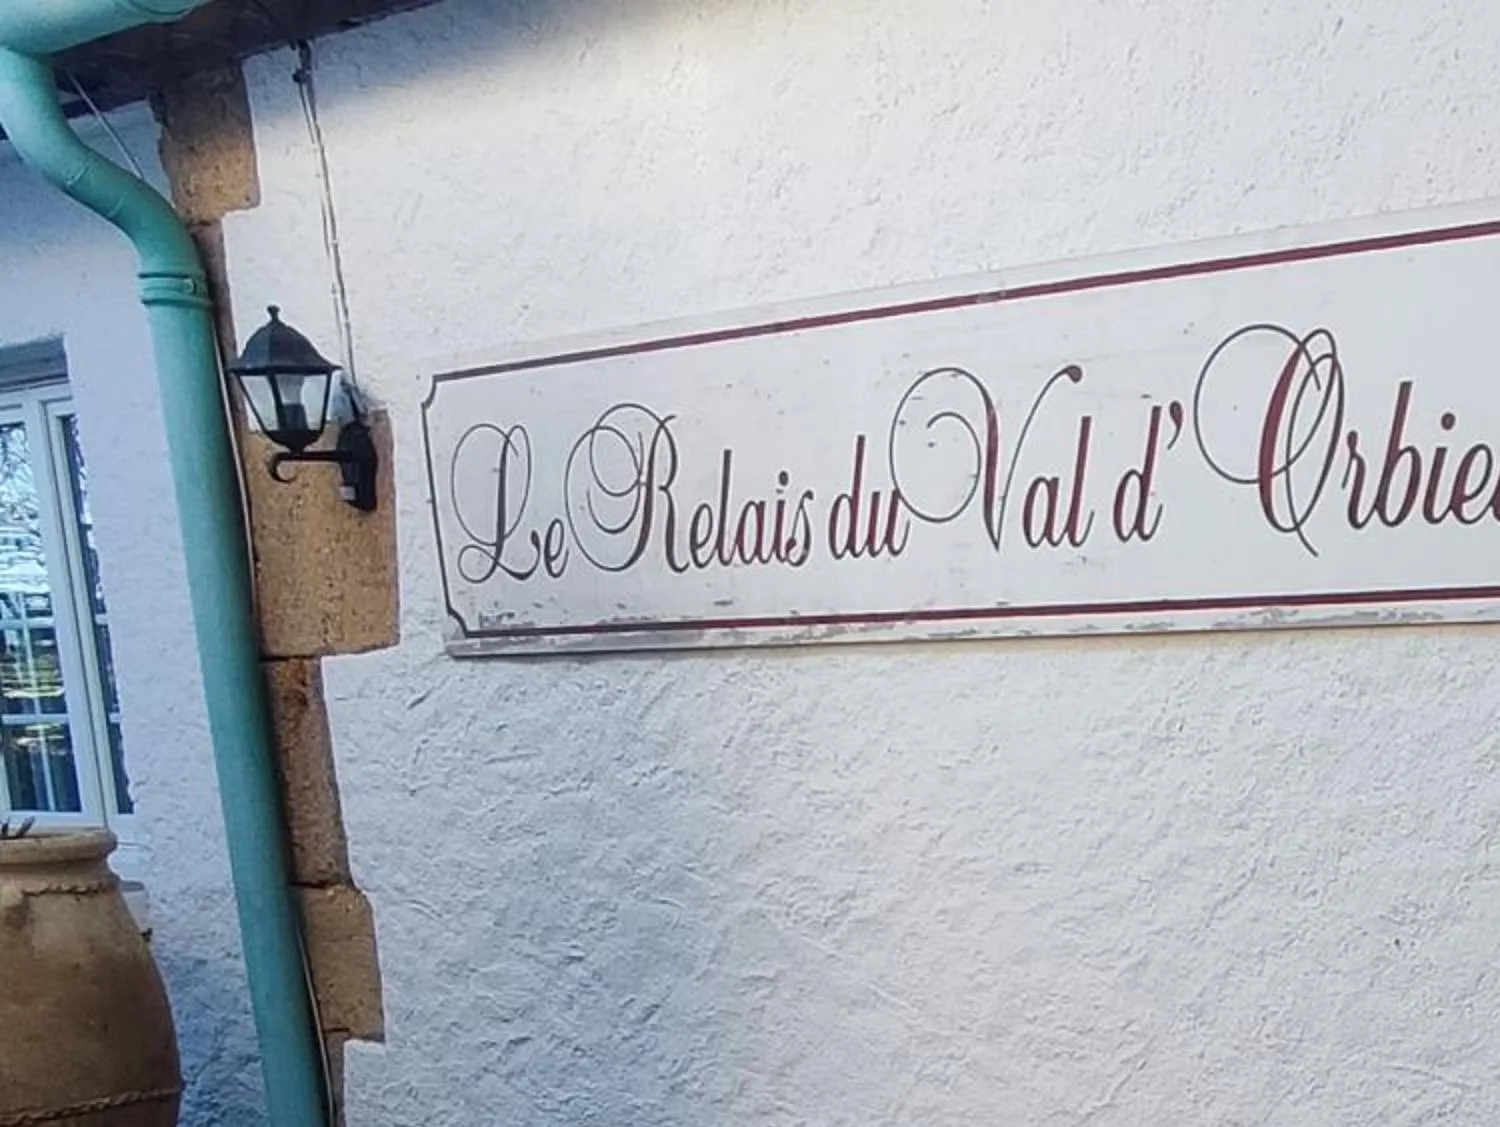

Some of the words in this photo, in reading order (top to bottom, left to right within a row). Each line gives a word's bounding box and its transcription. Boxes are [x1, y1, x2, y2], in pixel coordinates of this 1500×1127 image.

[451, 423, 568, 584] Le
[564, 403, 814, 573] Relais
[828, 435, 910, 559] du
[889, 367, 1095, 551] Val
